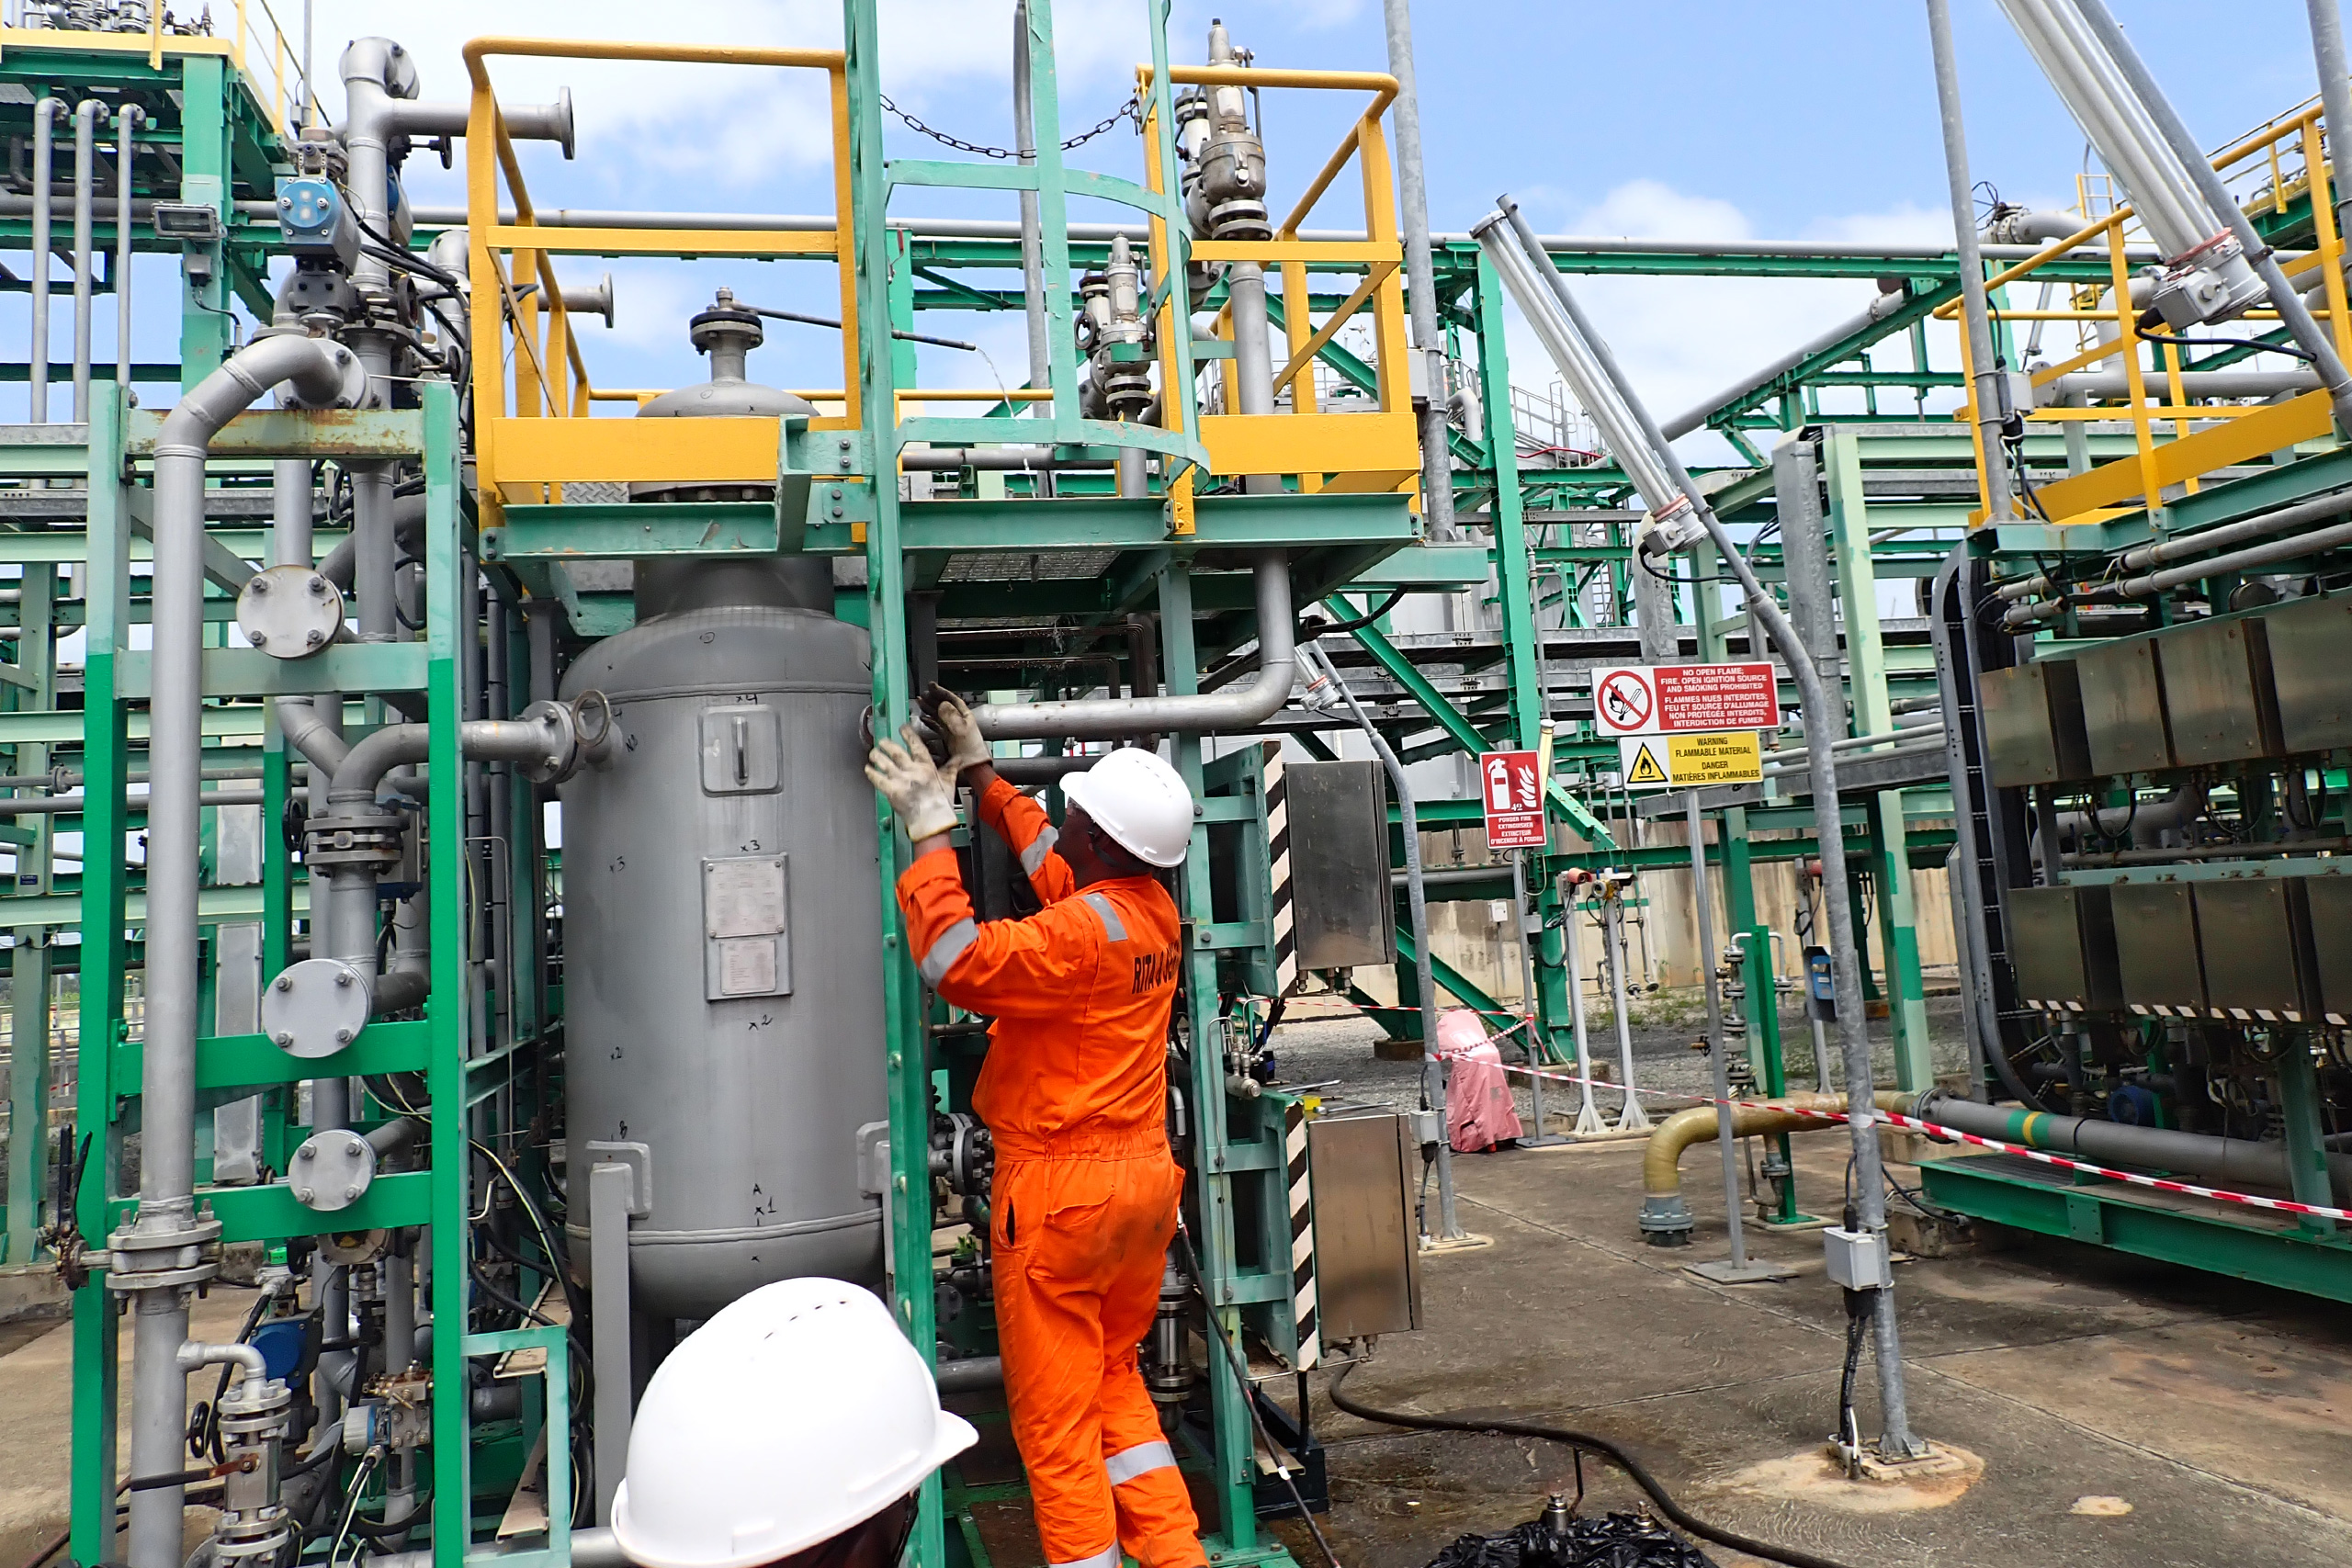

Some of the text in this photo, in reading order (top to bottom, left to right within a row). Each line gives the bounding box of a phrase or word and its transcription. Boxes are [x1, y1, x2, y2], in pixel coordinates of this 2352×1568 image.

[1720, 682, 1763, 691] PROHIBITED
[1665, 695, 1700, 704] FLAMMES
[1691, 703, 1723, 711] SOURCE
[1674, 718, 1725, 728] INTERDICTION
[1697, 737, 1727, 745] WARNING
[1676, 747, 1751, 757] FLAMMABLE MATERIAL
[1702, 761, 1728, 769] DANGER
[1673, 769, 1759, 782] MATIÈRES INFLAMMABLES
[1511, 803, 1522, 811] 42
[1132, 953, 1155, 994] RITA
[753, 1183, 762, 1195] A
